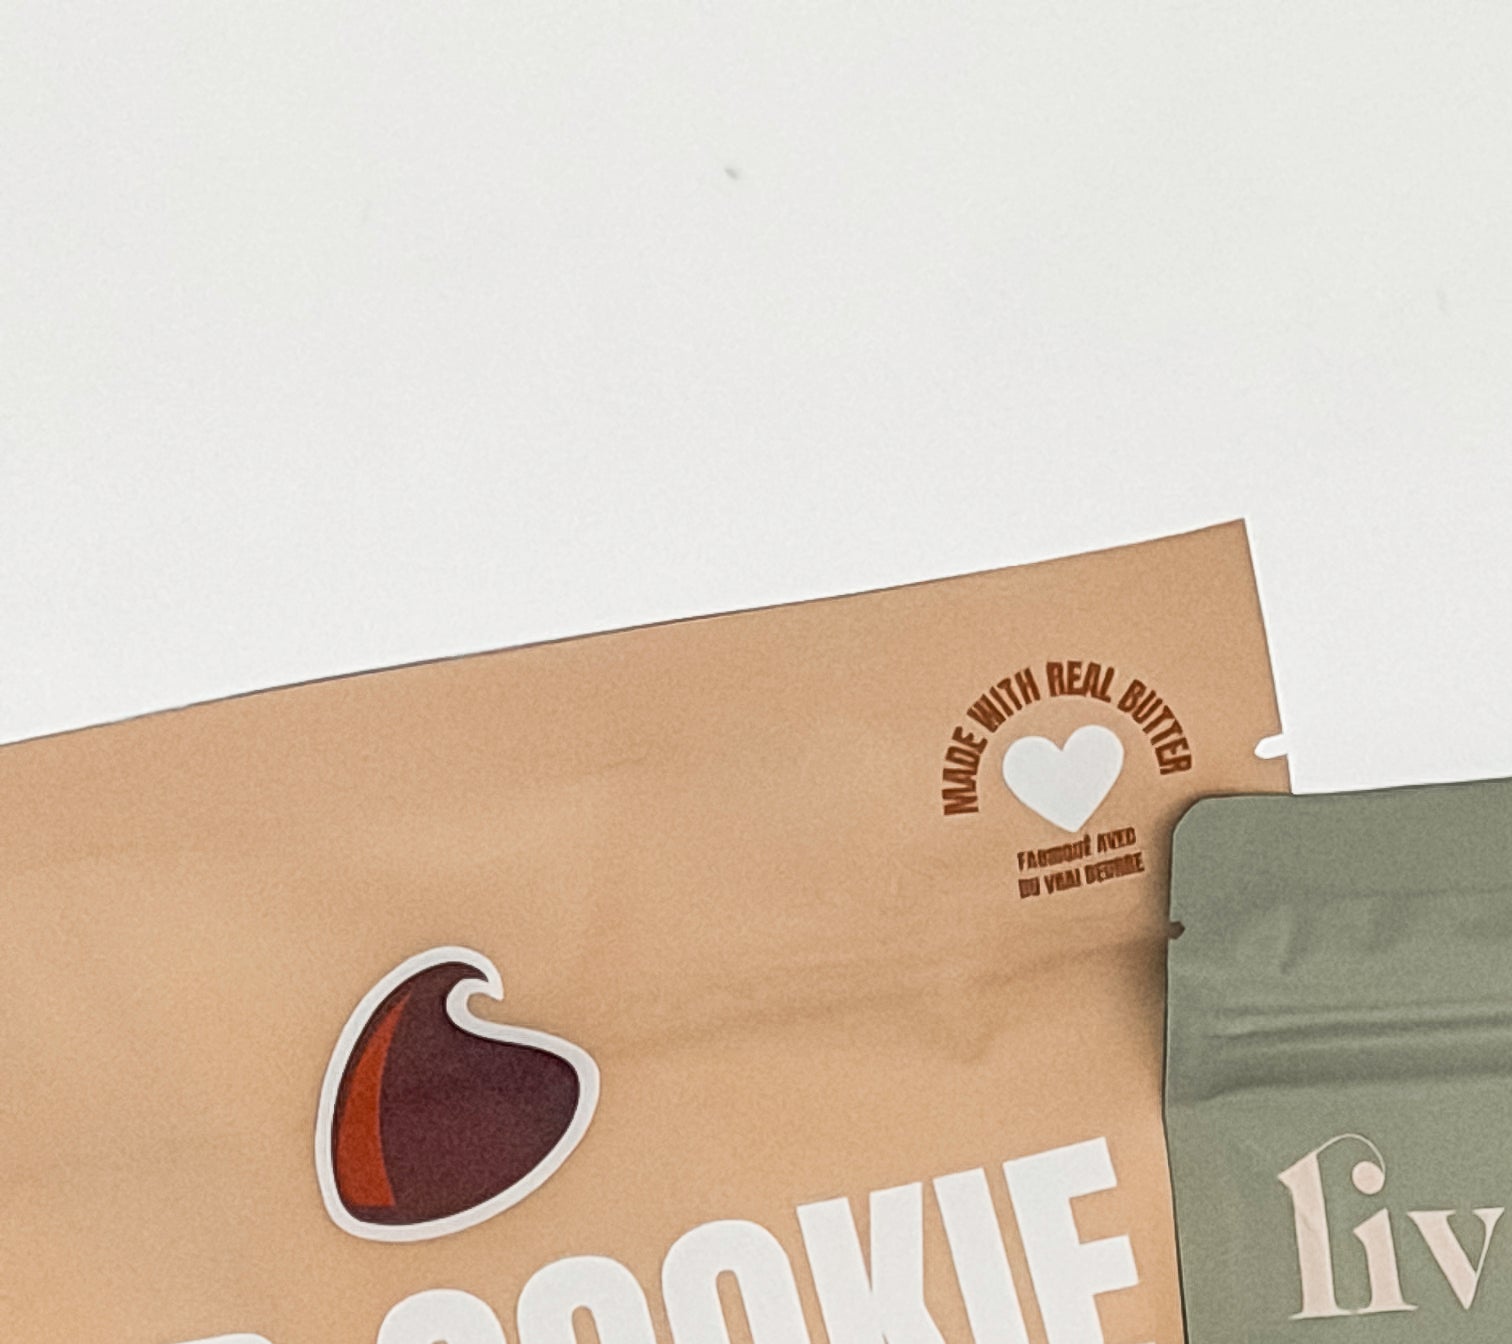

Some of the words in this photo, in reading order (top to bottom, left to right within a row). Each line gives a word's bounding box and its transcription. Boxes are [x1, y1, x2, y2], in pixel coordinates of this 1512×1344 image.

[942, 726, 988, 816] MADE
[967, 667, 1041, 733] WITH
[1046, 660, 1114, 703] REAL
[1117, 678, 1192, 775] BUTTER
